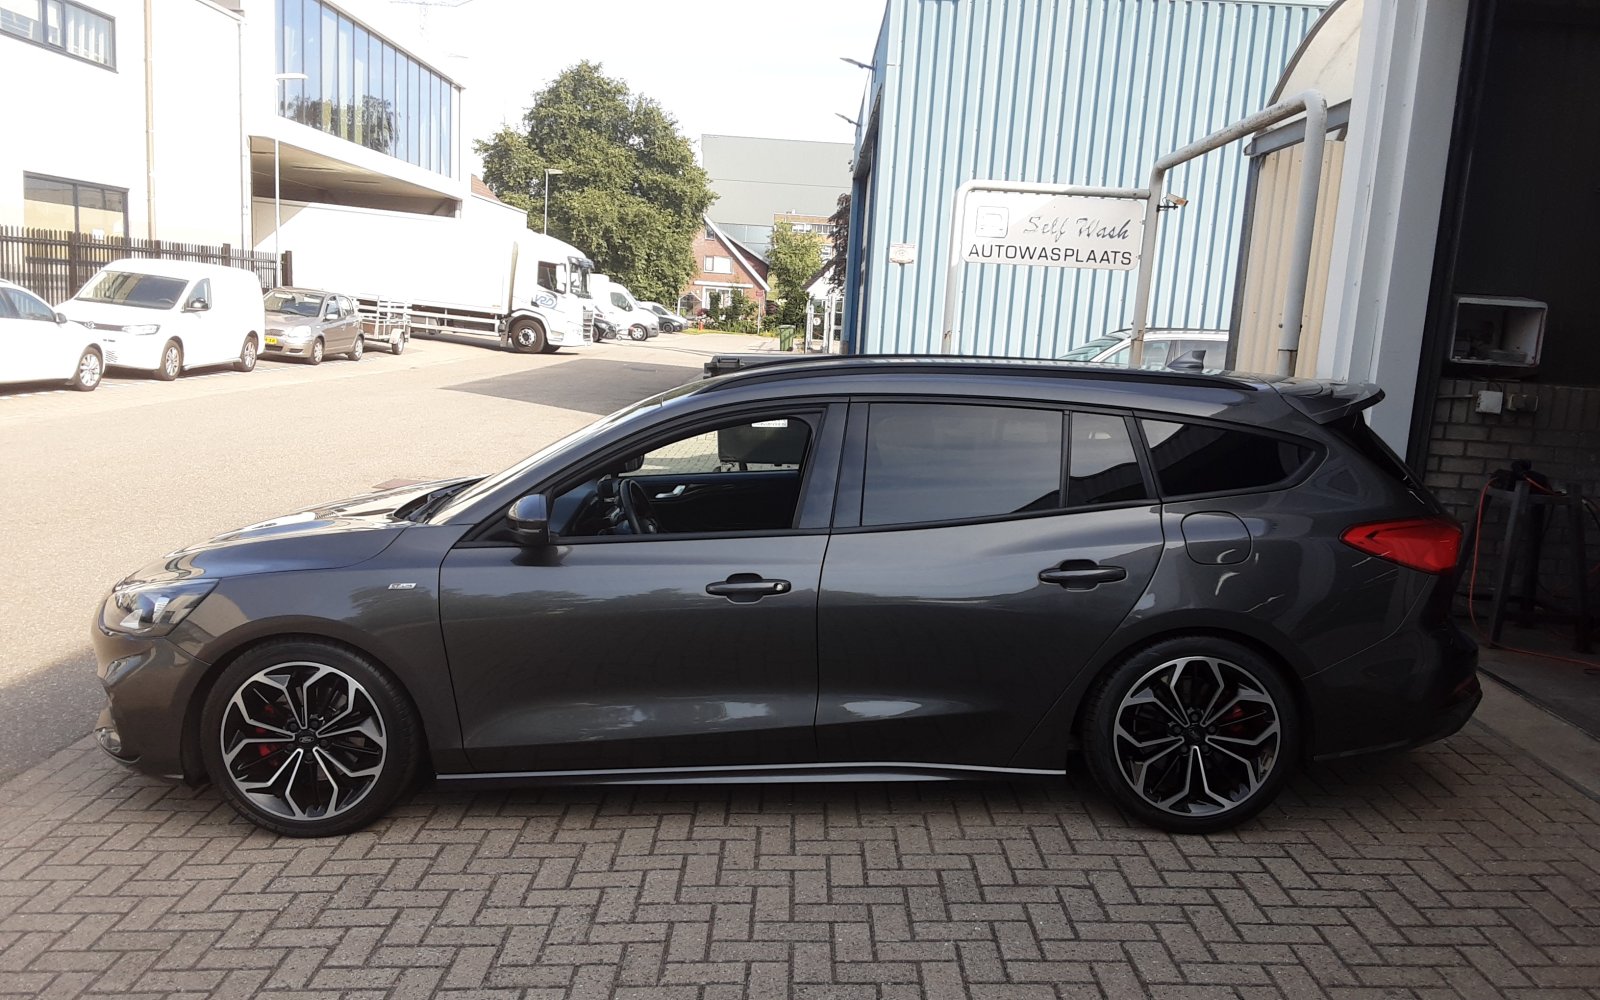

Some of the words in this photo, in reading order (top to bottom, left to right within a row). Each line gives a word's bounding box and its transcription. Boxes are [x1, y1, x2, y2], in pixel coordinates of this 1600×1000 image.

[1023, 216, 1069, 243] Self
[1076, 217, 1131, 240] Wash
[968, 243, 1132, 265] AUTOWASPLAATS
